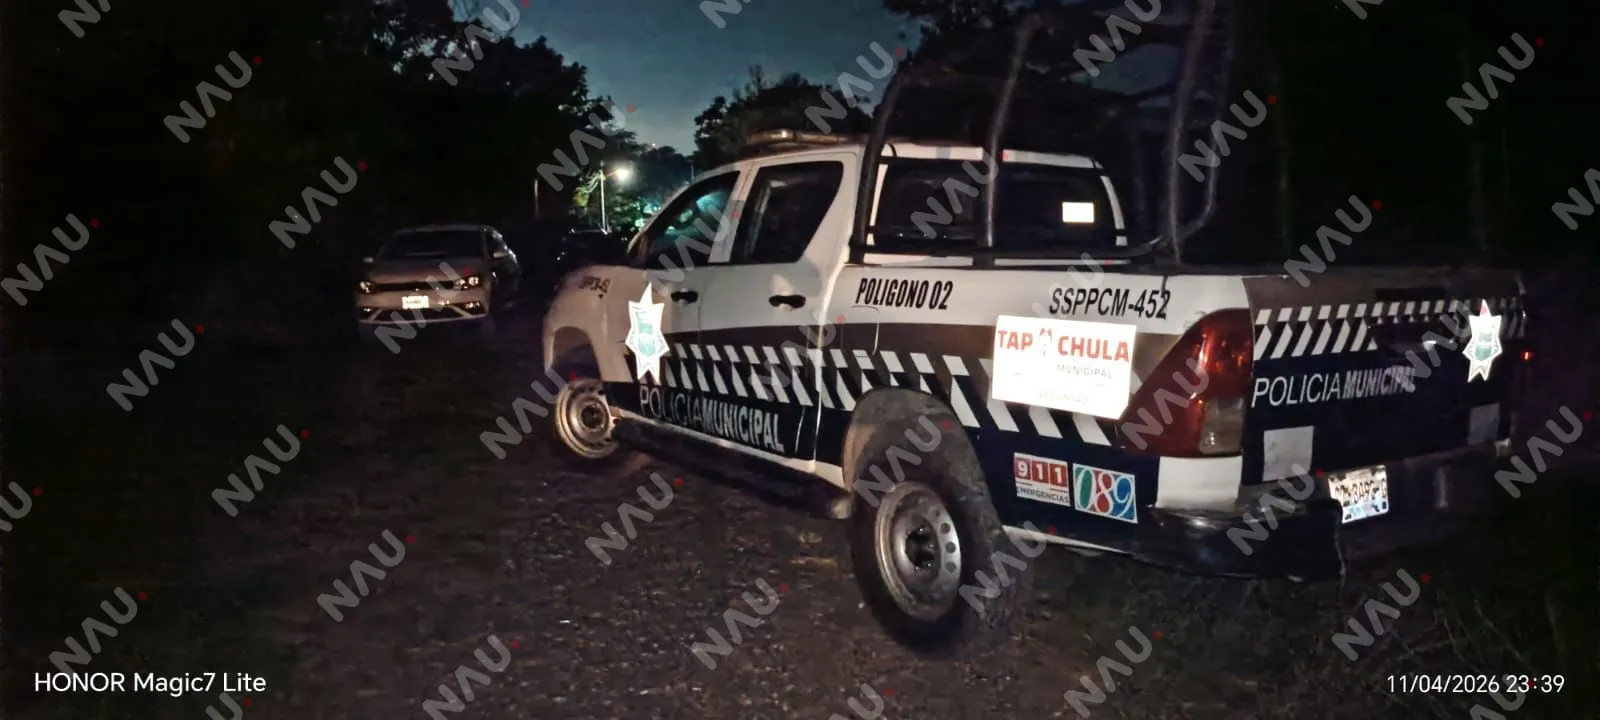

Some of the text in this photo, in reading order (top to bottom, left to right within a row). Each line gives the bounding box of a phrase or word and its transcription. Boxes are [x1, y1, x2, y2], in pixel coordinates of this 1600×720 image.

[855, 277, 953, 309] POLIGONO 02
[1049, 287, 1171, 319] SSPPCM-452
[1057, 335, 1129, 363] CHULA
[1056, 363, 1113, 379] MUNICIPAL
[1018, 461, 1064, 484] 911
[1077, 466, 1132, 518] 089
